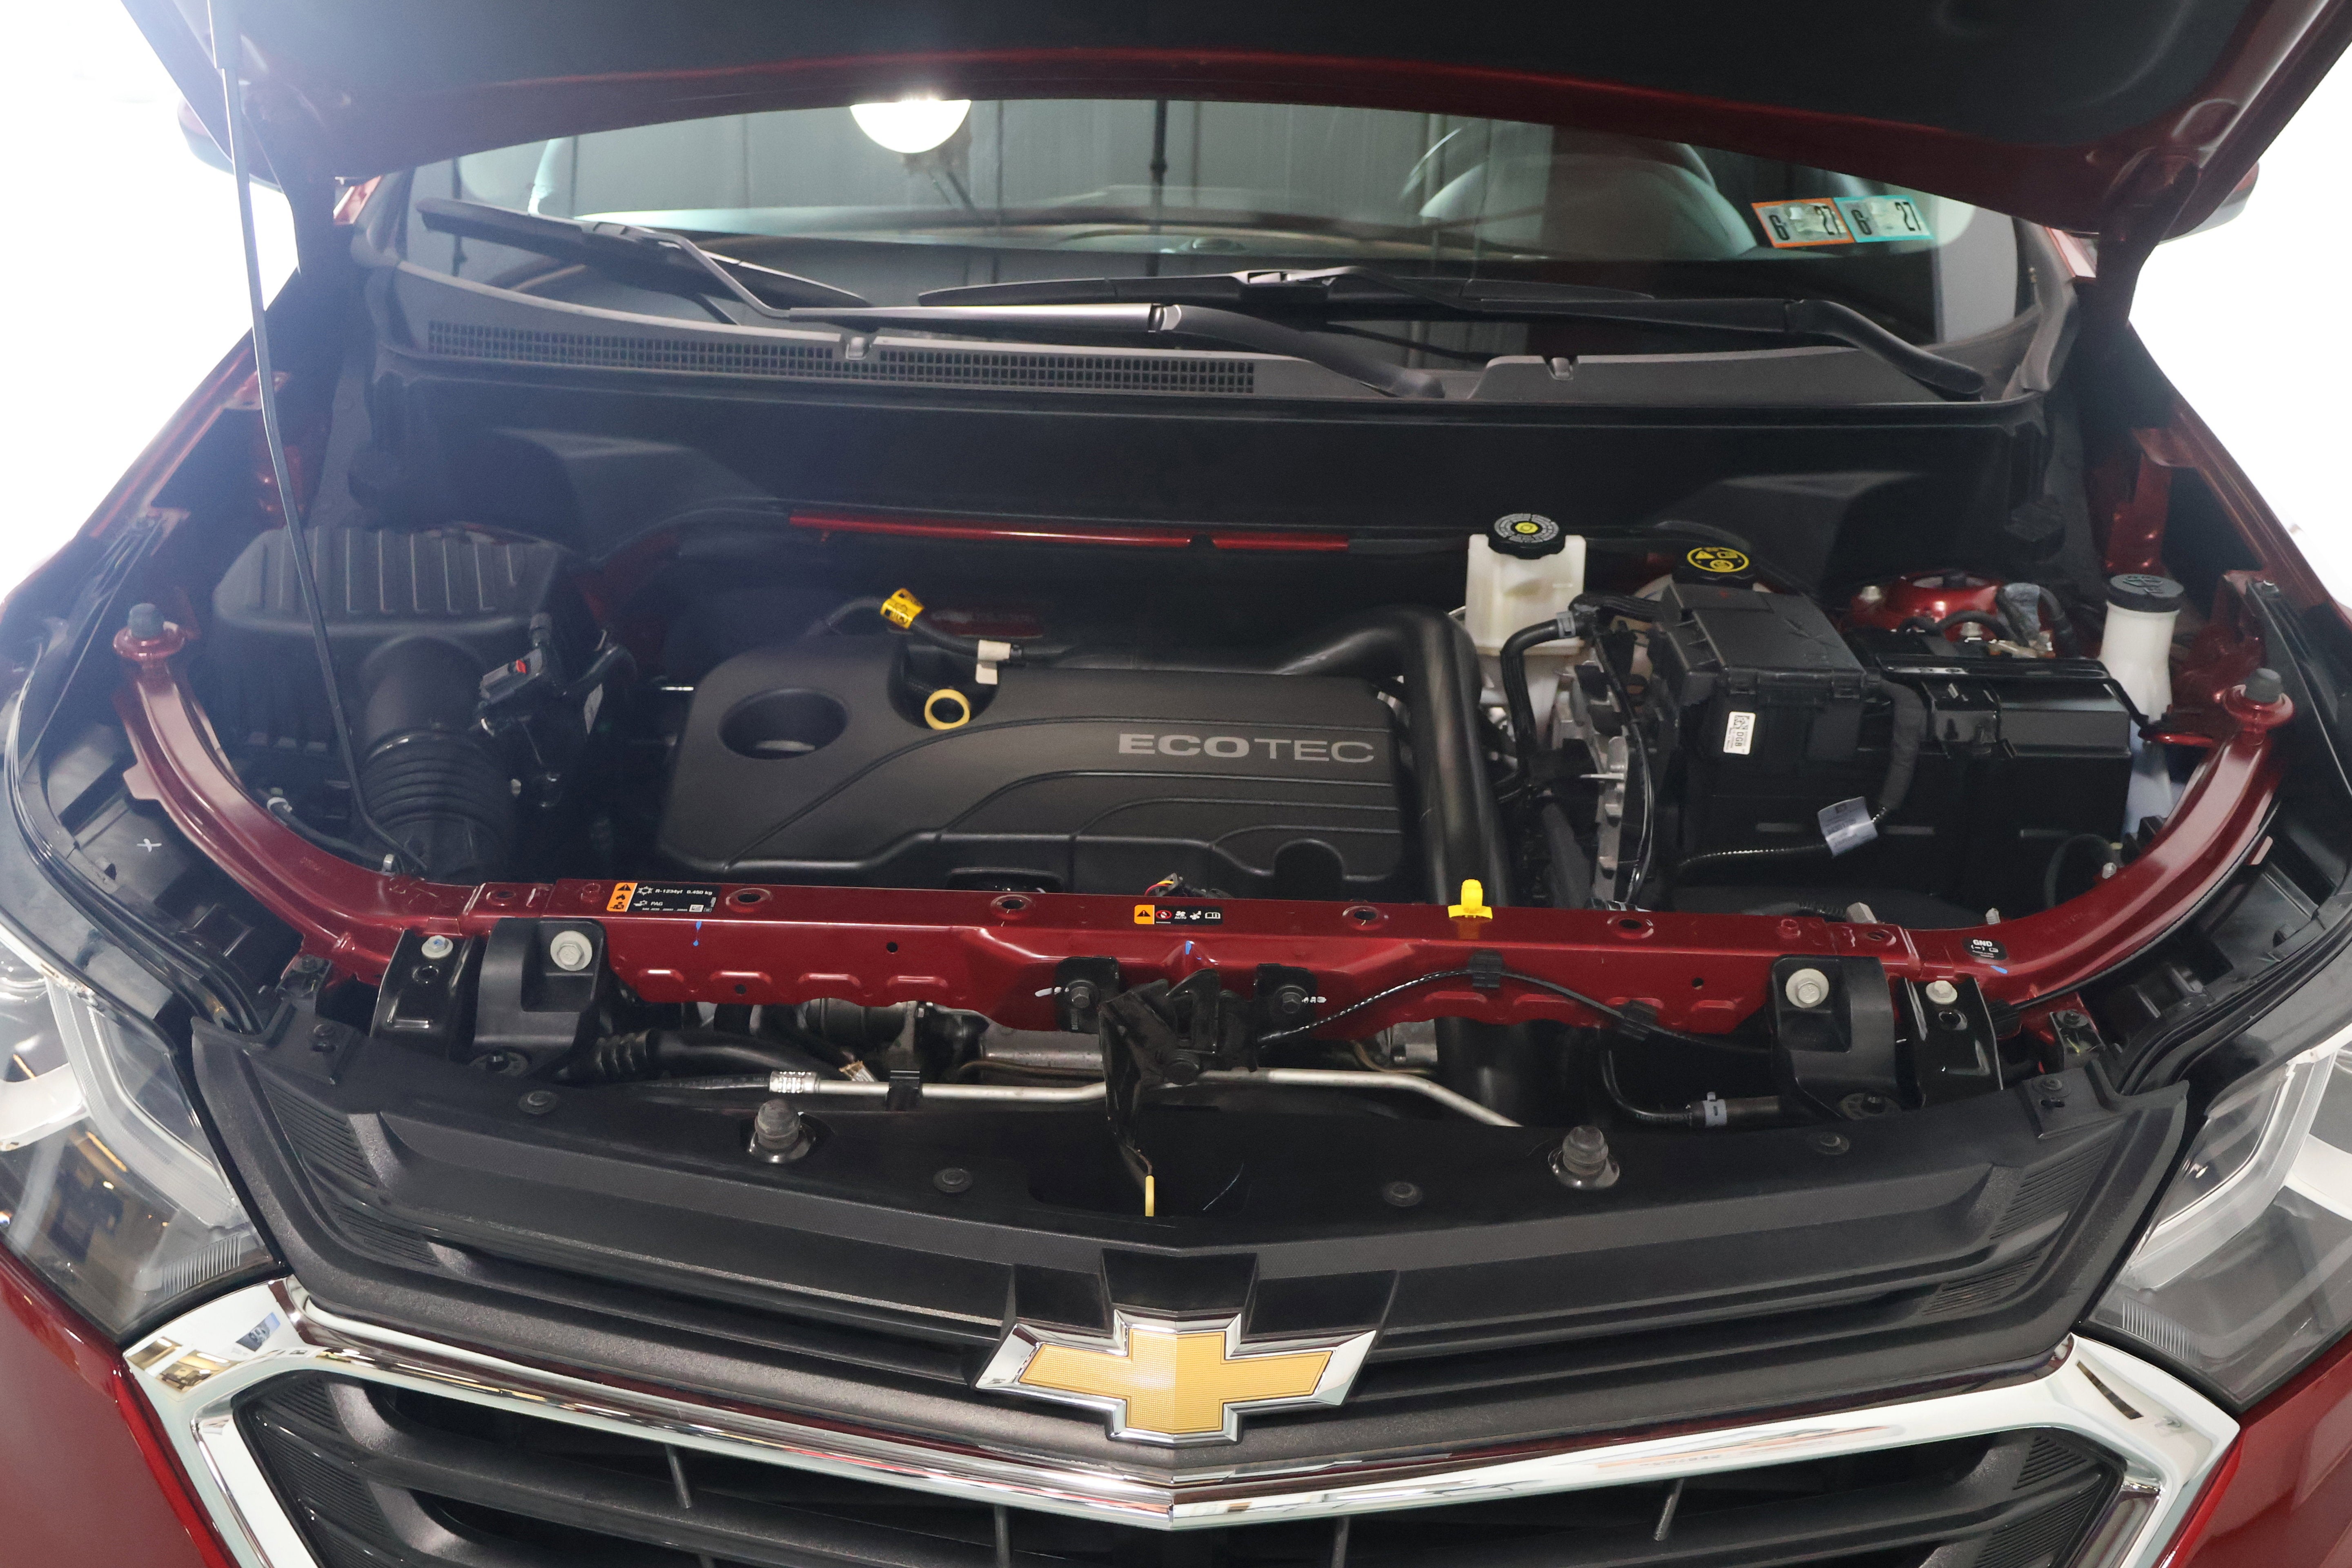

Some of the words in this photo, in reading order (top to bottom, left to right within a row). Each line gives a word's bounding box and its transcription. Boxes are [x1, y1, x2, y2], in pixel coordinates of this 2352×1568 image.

[1851, 209, 1873, 236] 6
[1895, 201, 1922, 232] 27
[1118, 733, 1375, 763] ECOTEC
